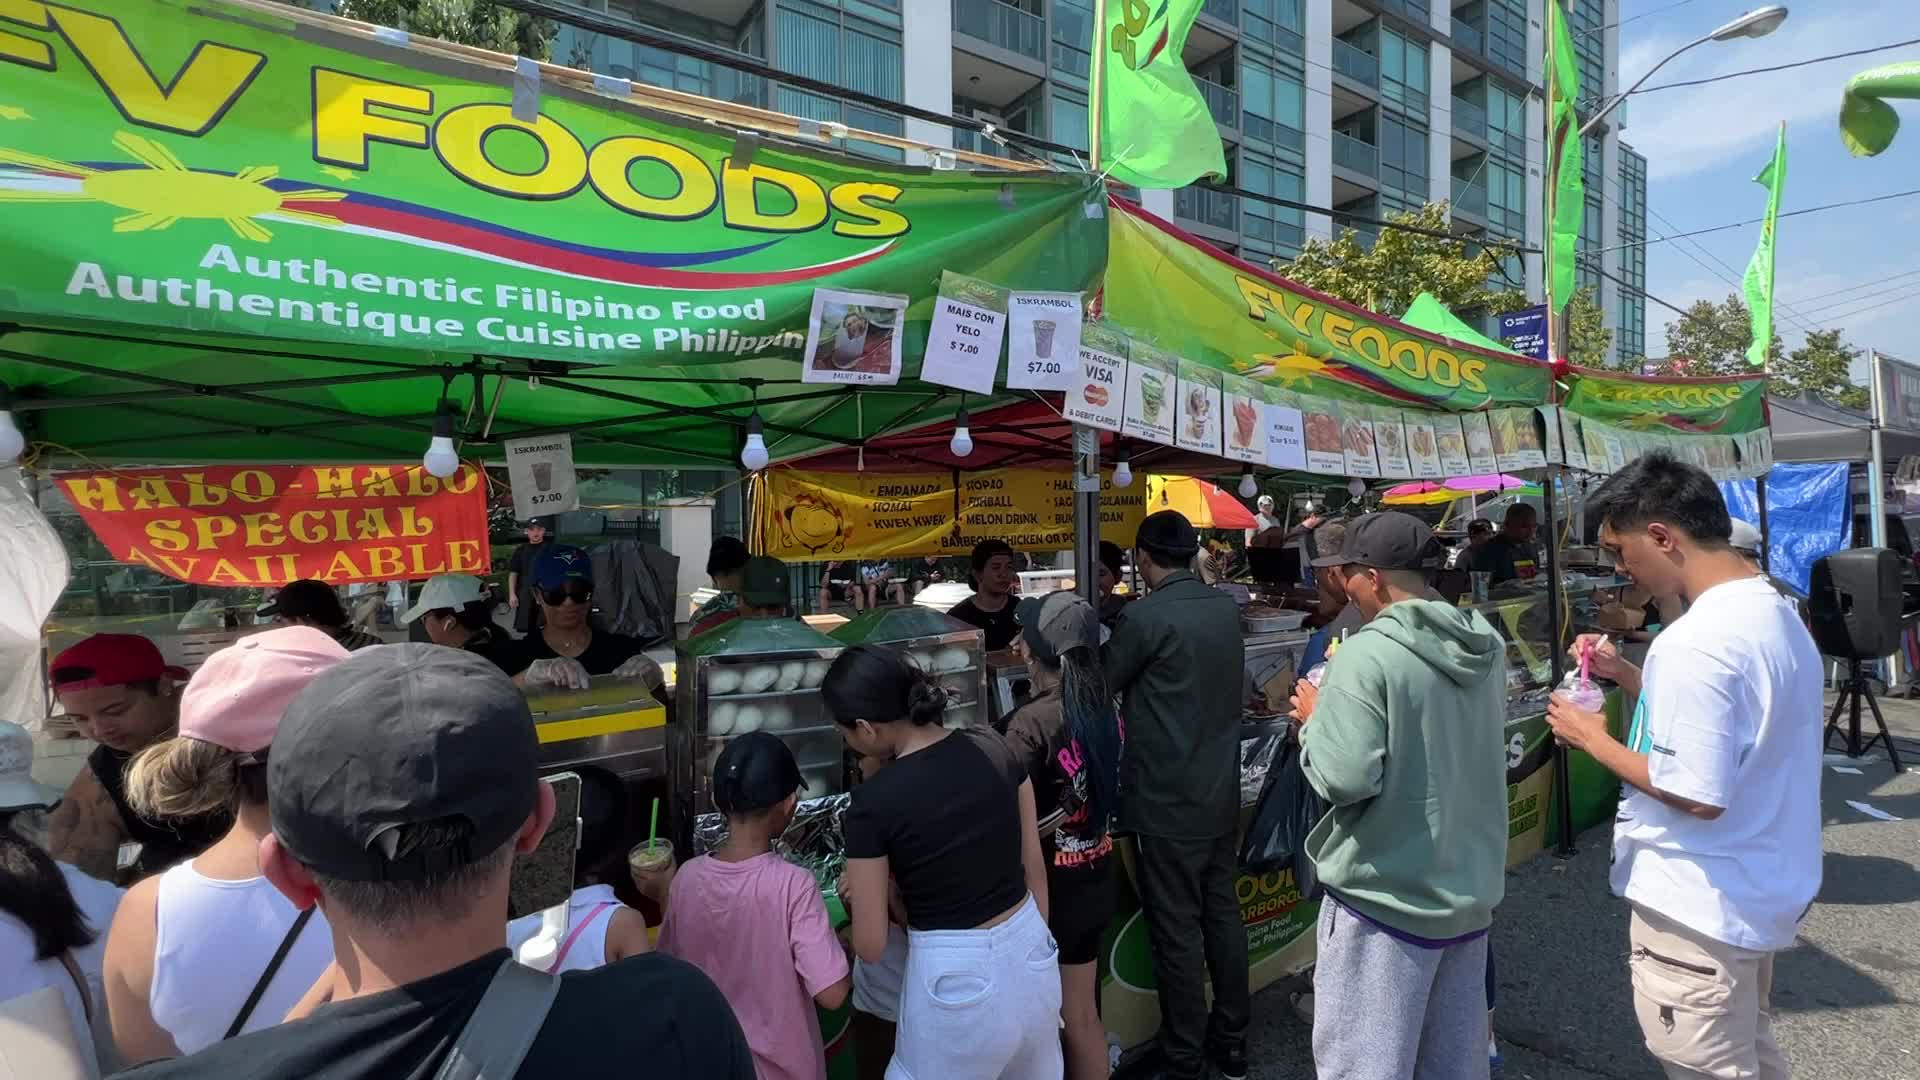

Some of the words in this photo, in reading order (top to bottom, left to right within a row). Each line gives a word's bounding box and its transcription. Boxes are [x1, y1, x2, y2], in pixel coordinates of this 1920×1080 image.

[311, 66, 911, 238] FOODS
[199, 243, 484, 306] Authentic
[496, 283, 662, 321] Filipino
[671, 298, 766, 321] Food
[65, 261, 464, 338] Authentique
[476, 317, 641, 351] Cuisine
[1015, 296, 1074, 309] ISKRAMBOL
[1235, 274, 1315, 337] FV
[946, 304, 973, 319] MAIS
[974, 311, 996, 325] CON
[955, 322, 981, 338] YELO
[959, 343, 979, 355] 7.00
[1027, 361, 1061, 375] $7.00
[1092, 354, 1121, 369] ACCEPT
[1085, 363, 1113, 385] VISA
[1075, 409, 1096, 420] DEBIT
[1095, 414, 1117, 427] CARDS
[514, 443, 565, 455] ISKRAMBOL
[878, 484, 941, 497] EMPANADA
[965, 479, 1003, 490] SIOPAO
[532, 492, 562, 504] $7.00
[872, 501, 913, 512] SIOMAI
[874, 517, 912, 529] KWEK
[912, 514, 946, 527] KWEK
[966, 513, 1003, 525] MELON
[1005, 513, 1038, 525] DRINK
[144, 506, 434, 552] SPECIAL
[999, 533, 1044, 547] CHICKEN
[1045, 532, 1061, 545] OR
[128, 540, 484, 586] AVAILABLE
